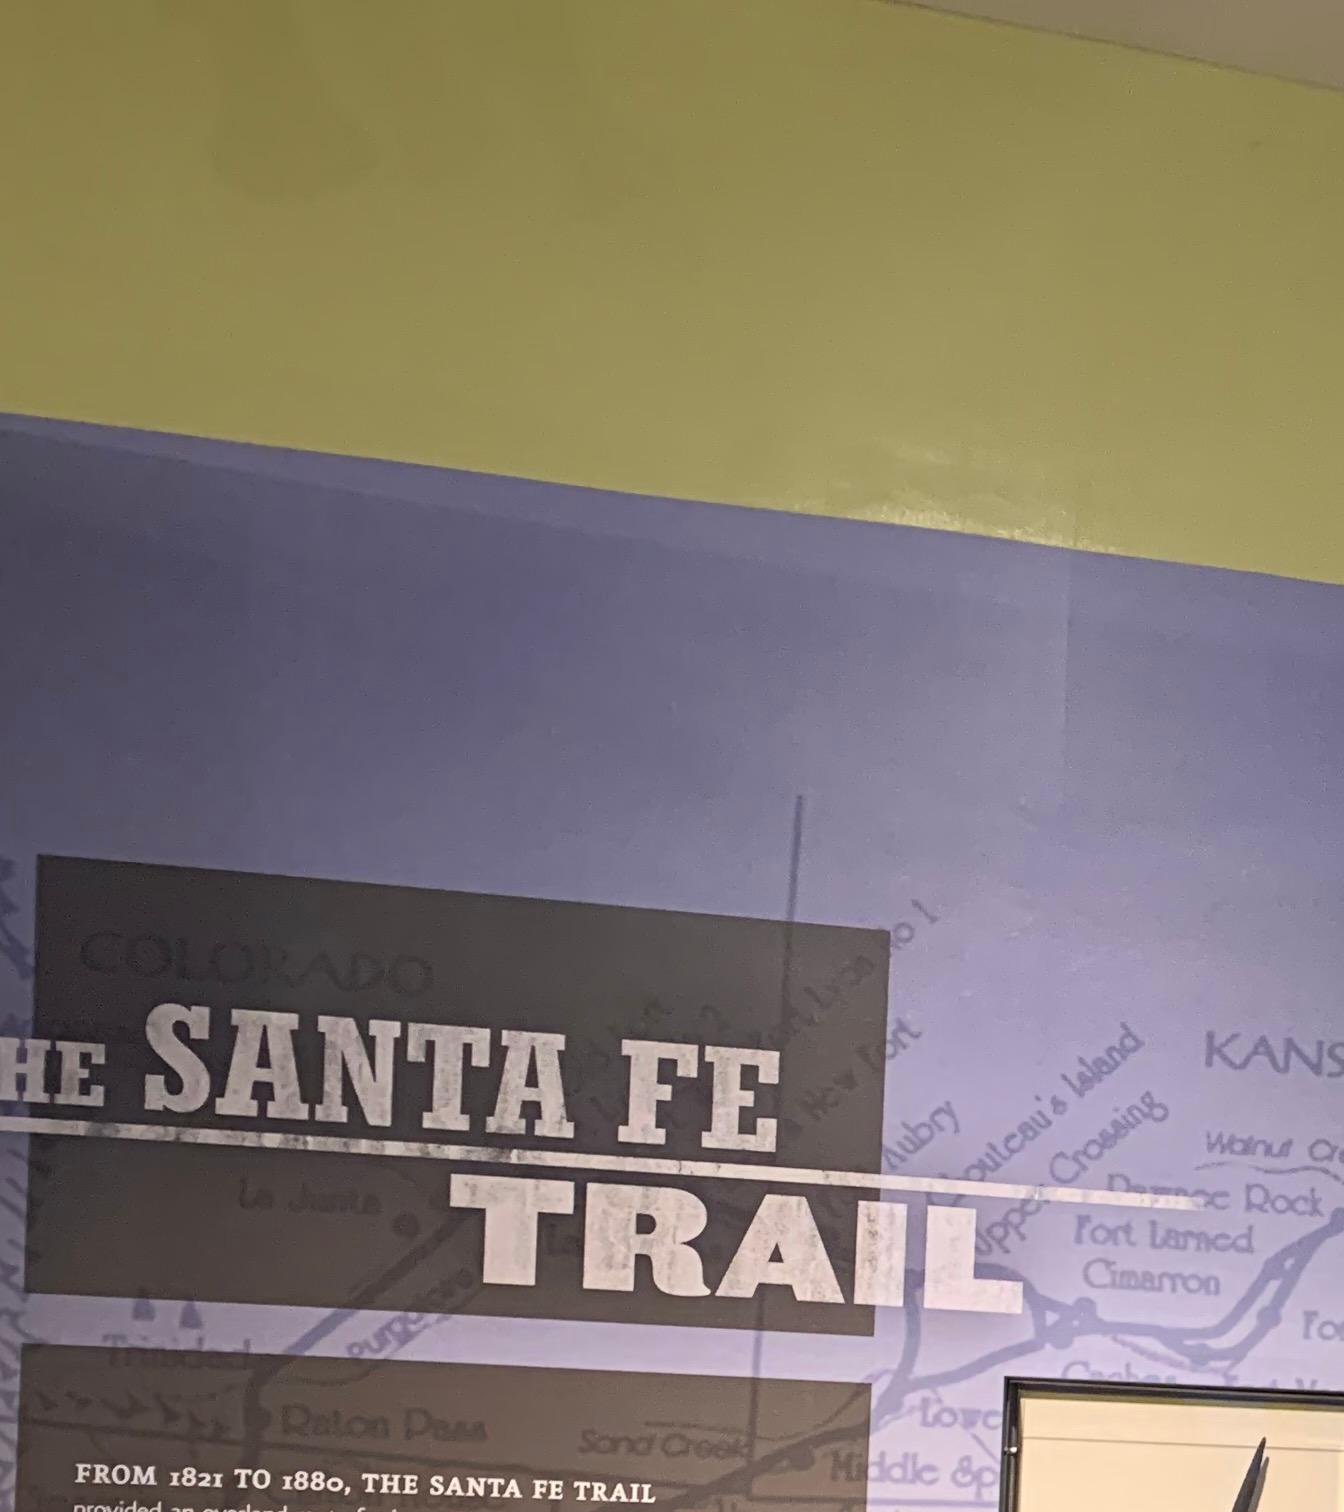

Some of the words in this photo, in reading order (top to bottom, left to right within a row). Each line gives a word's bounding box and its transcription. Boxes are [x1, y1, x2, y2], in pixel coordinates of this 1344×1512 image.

[79, 930, 434, 998] COLORADO
[0, 1037, 106, 1108] HE
[144, 1002, 576, 1139] SANTA
[617, 1037, 781, 1153] FE
[881, 1100, 960, 1172] Aubry
[1049, 1090, 1170, 1185] Crossing
[1074, 1214, 1137, 1248] Fort
[1245, 1183, 1325, 1218] Rock
[450, 1173, 1024, 1315] TRAIL
[75, 1463, 157, 1486] FROM
[170, 1467, 223, 1488] 1821
[234, 1468, 270, 1490] TO
[282, 1470, 350, 1496] 1880,
[362, 1473, 418, 1494] THE
[430, 1475, 522, 1499] SANTA
[532, 1479, 563, 1500] FE
[574, 1480, 656, 1504] TRAIL
